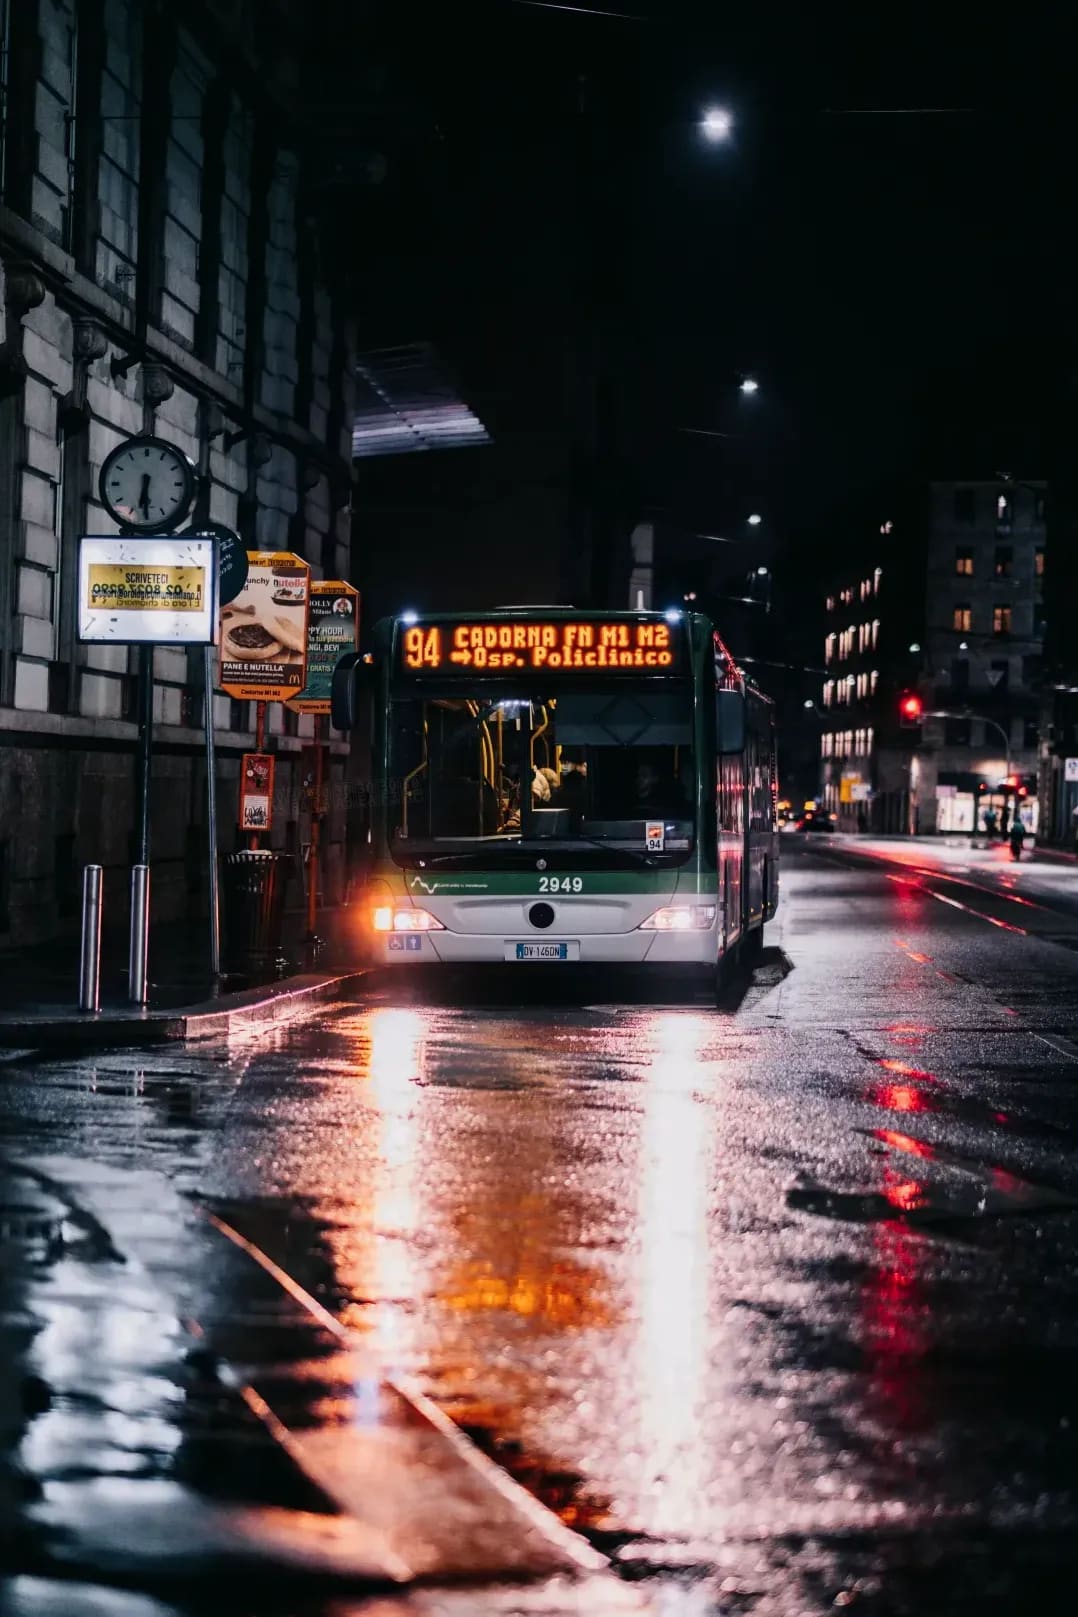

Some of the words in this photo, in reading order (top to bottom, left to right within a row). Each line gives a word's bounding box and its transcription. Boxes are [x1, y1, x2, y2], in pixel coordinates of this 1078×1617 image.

[125, 572, 169, 584] SCRIVETECI
[454, 625, 558, 648] CADORNA
[564, 625, 593, 647] FN
[601, 625, 629, 647] M1
[638, 625, 669, 647] M2
[405, 627, 441, 668] 94
[474, 646, 525, 667] Osp.
[532, 645, 673, 667] Policlinico
[223, 662, 243, 671] PANE
[243, 663, 249, 671] E
[250, 664, 284, 672] NUTELLA
[649, 839, 661, 849] 94
[538, 876, 584, 893] 2949
